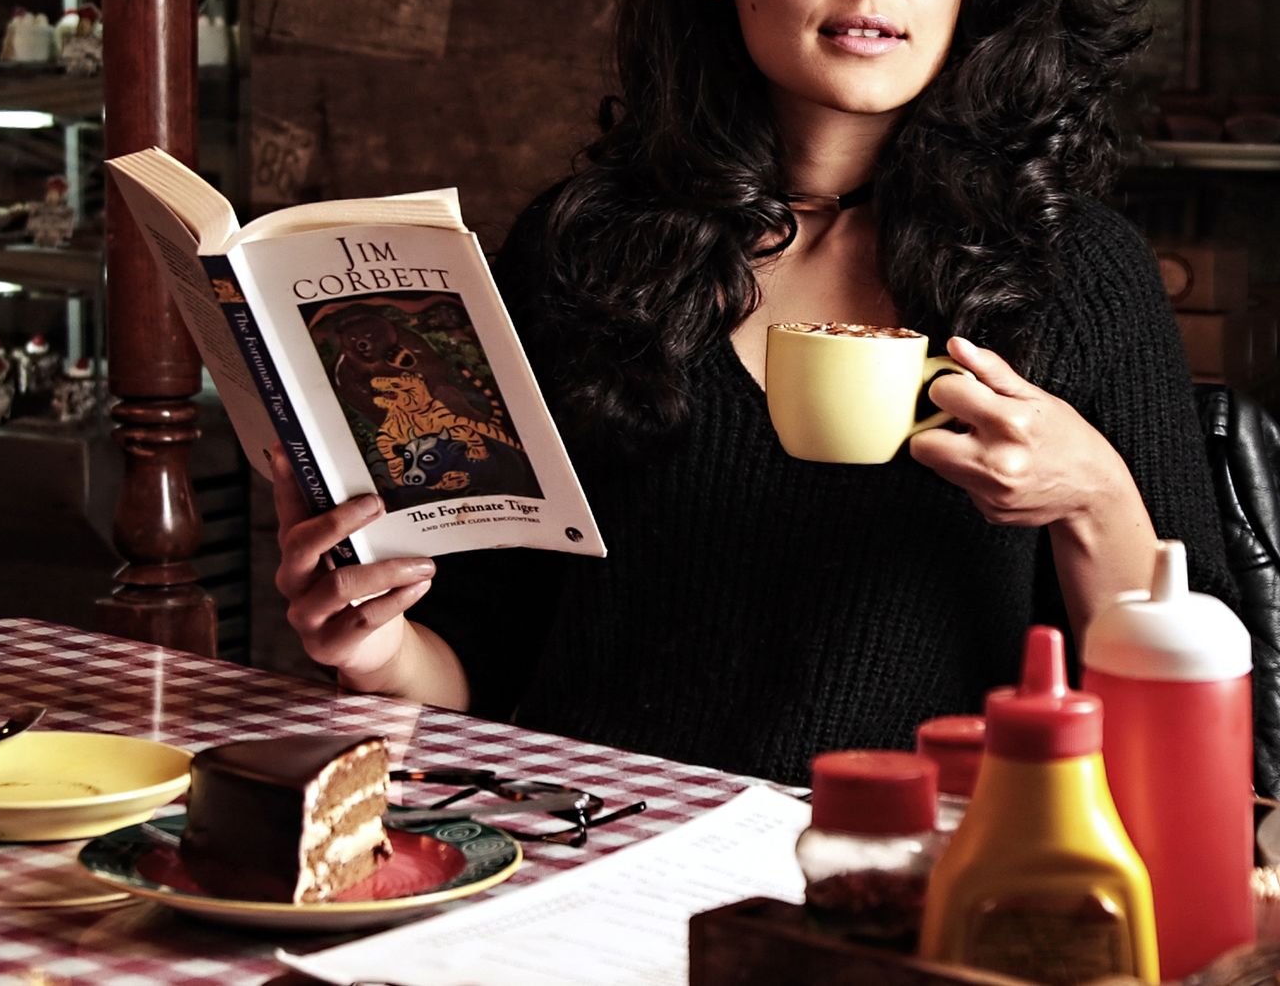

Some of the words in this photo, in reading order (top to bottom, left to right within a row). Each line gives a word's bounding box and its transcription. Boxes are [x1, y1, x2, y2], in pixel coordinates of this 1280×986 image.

[293, 268, 450, 300] CORBETT
[234, 310, 249, 333] The
[245, 337, 274, 391] Fortunate
[270, 394, 288, 422] Tiger
[288, 440, 309, 462] JIM
[407, 510, 436, 523] The
[439, 502, 504, 517] Fortunate
[505, 499, 540, 515] Tiger
[421, 524, 438, 533] AND
[439, 519, 466, 528] OTHER
[468, 517, 491, 525] CLOSE
[493, 516, 541, 524] ENCOUNTERS
